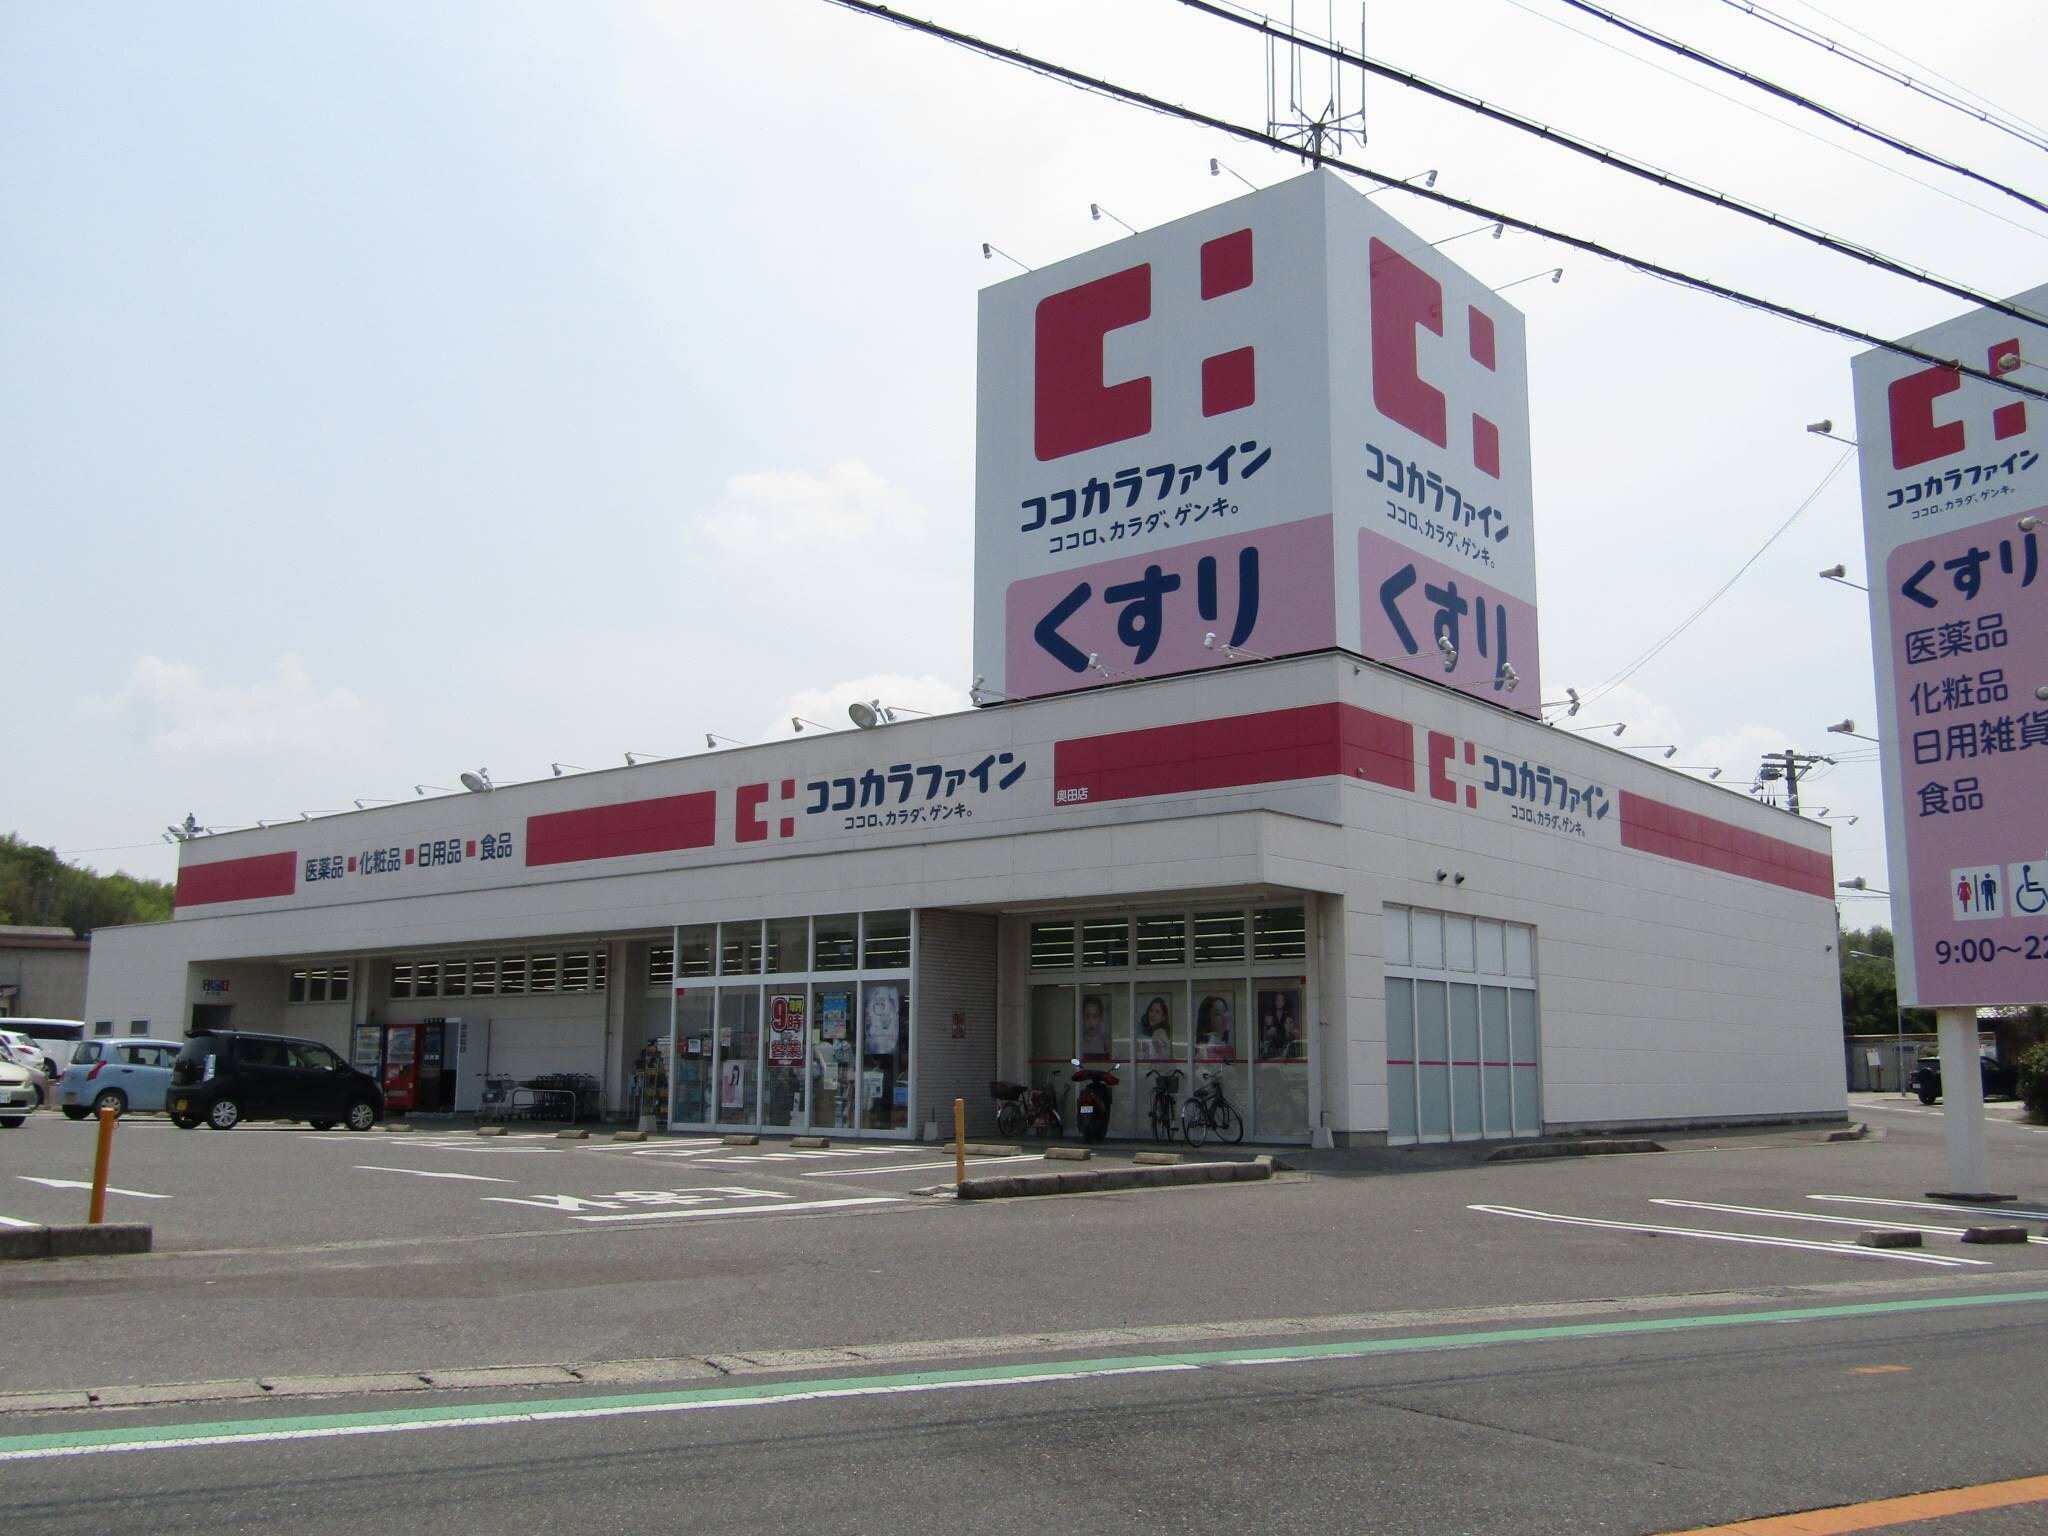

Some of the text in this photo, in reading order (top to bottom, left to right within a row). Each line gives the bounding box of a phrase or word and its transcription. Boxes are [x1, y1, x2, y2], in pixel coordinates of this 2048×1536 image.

[1020, 440, 1272, 533] ココカラファイン
[1365, 443, 1509, 543] ココカラファイン
[1887, 450, 2039, 509] ココカラファイン
[1049, 497, 1240, 554] ココロ、カラダ、ゲンキ。
[1901, 533, 2038, 609] くすり
[1034, 546, 1260, 673] くすり
[1379, 563, 1508, 691] くすり
[1904, 613, 2008, 665] 医薬品
[1910, 669, 2009, 716] 化粧品
[1914, 709, 2048, 765] 日用雑貨
[806, 752, 1026, 814] ココカラファイン
[1483, 754, 1609, 820] ココカラファイン
[1918, 777, 1984, 817] 食品
[844, 803, 972, 830] ココロ、カラダ、ゲンキ。
[305, 832, 512, 882] 医薬品 化粧品 日用品 食品
